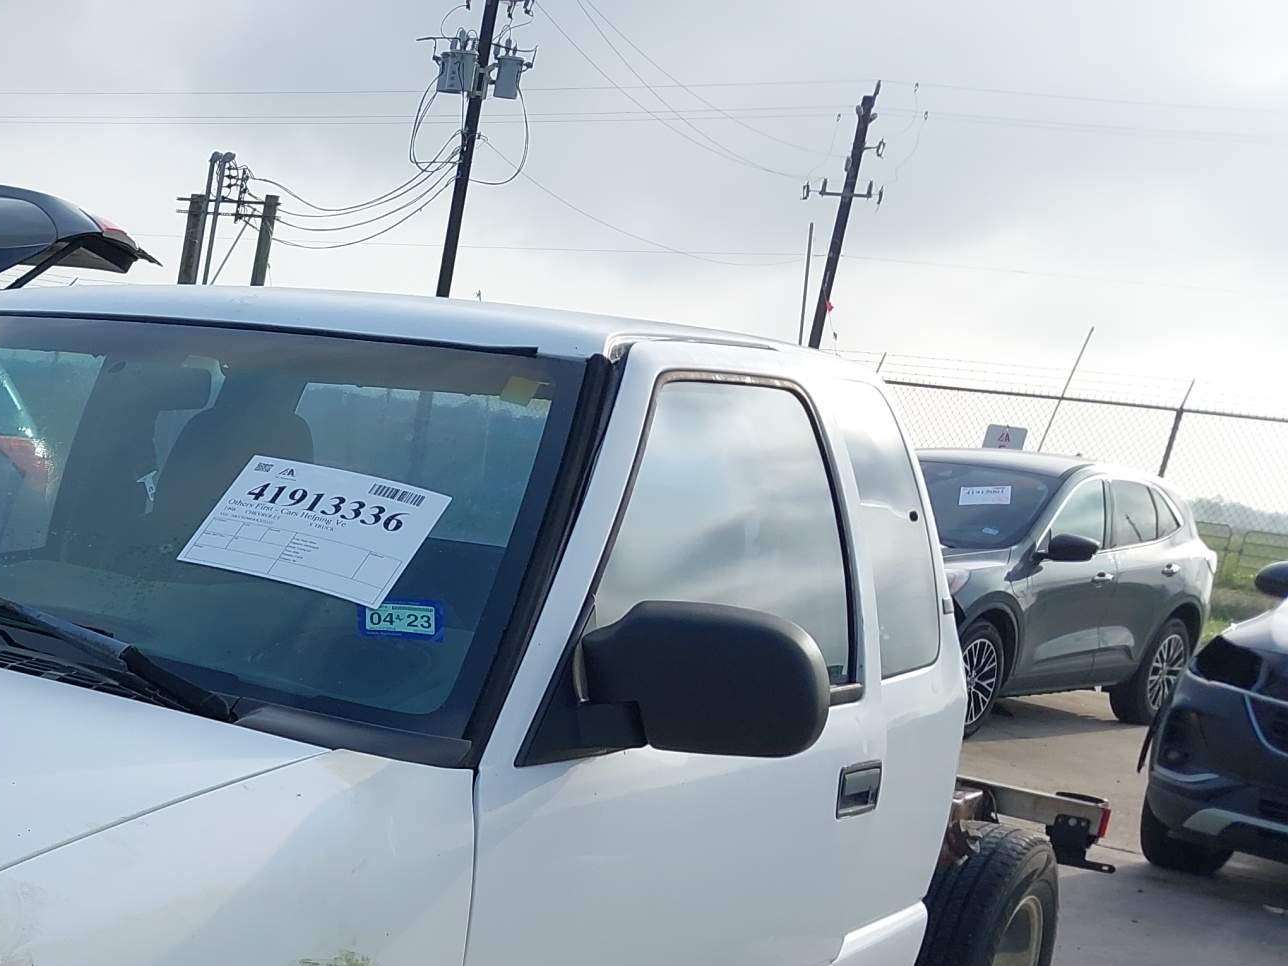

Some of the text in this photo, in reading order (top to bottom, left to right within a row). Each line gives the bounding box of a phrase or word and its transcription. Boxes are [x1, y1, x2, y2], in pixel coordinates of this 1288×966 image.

[228, 498, 254, 508] Others
[254, 503, 274, 512] First
[280, 509, 298, 517] Cars
[300, 511, 333, 525] Helping
[247, 482, 410, 532] 41913336
[369, 612, 432, 629] 04 23
